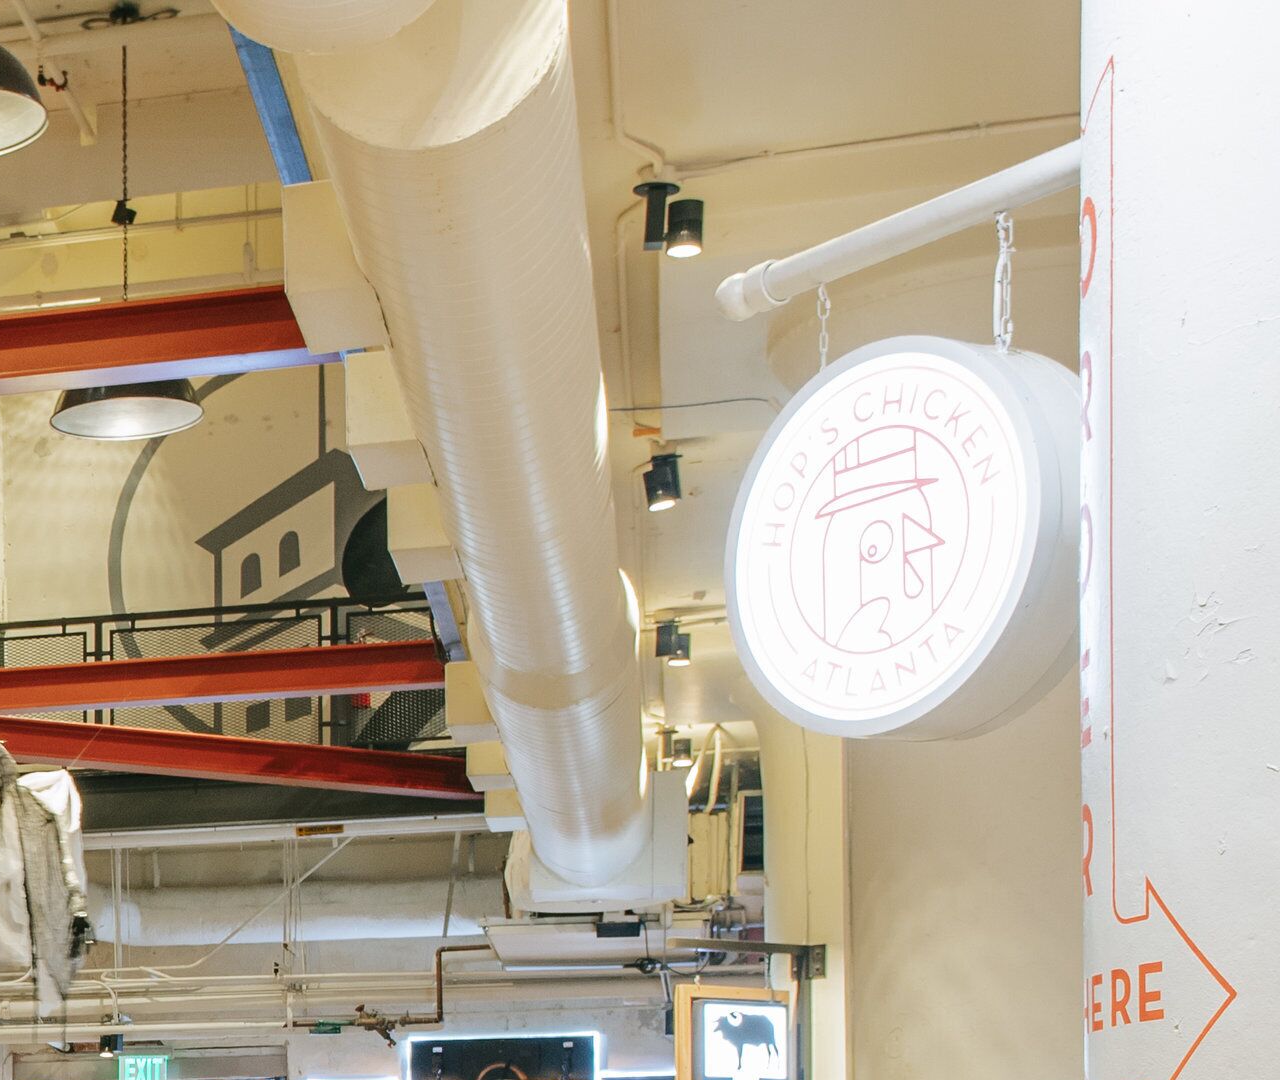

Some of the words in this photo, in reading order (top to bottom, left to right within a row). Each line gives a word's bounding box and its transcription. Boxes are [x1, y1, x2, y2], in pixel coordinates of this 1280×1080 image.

[762, 417, 840, 548] HOP'S
[852, 382, 1001, 487] CHICKEN
[801, 622, 966, 697] ATLANTA
